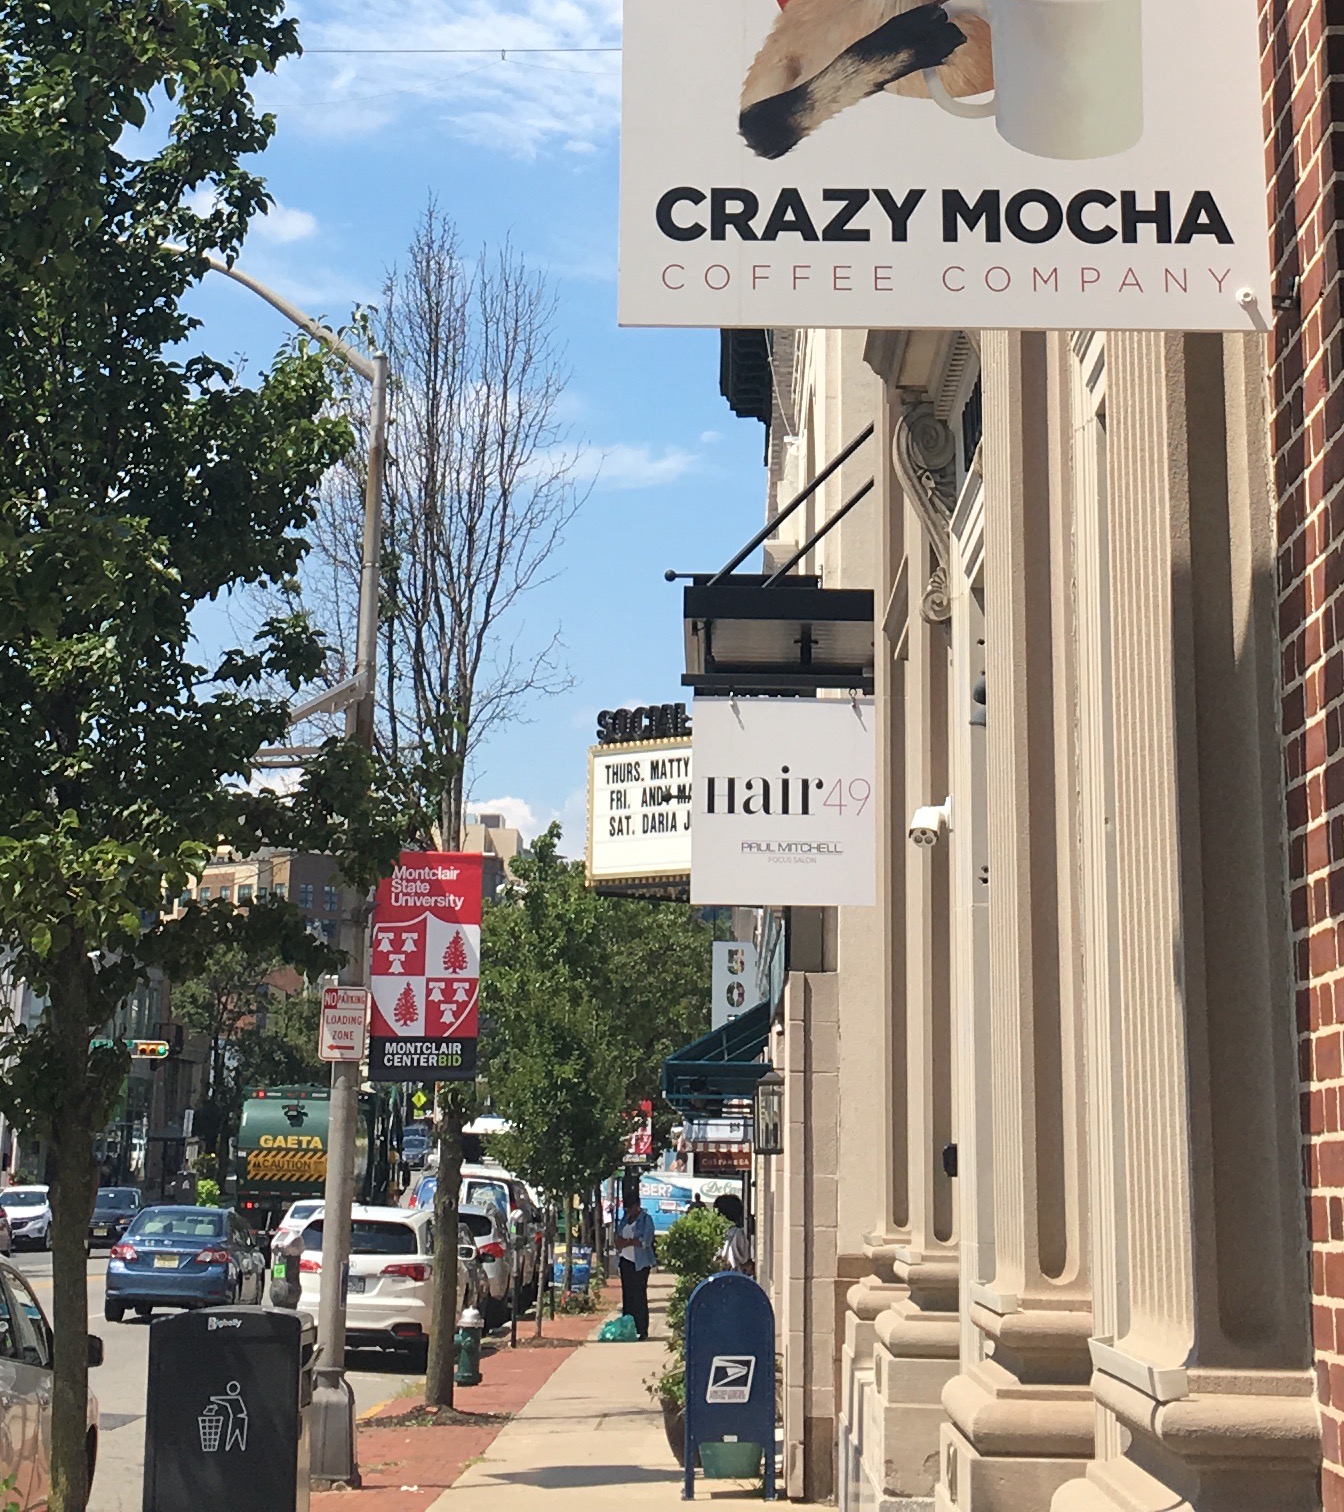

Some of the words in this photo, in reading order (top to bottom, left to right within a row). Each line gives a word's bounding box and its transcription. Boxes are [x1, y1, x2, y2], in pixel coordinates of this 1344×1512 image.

[656, 187, 926, 242] CRAZY
[942, 189, 1234, 244] MOCHA
[662, 264, 895, 292] COFFEE
[942, 265, 1232, 294] COMPANY
[605, 761, 644, 785] THURS.
[650, 757, 690, 780] MATTY
[610, 789, 631, 810] FRI.
[641, 785, 671, 807] ANDY
[609, 815, 635, 837] SAT.
[642, 811, 677, 834] DARIA
[741, 842, 775, 852] PAUL
[778, 843, 843, 854] MITCHELL
[768, 856, 791, 864] FOCUS
[392, 866, 460, 880] Montclair
[391, 879, 430, 893] State
[391, 892, 464, 910] University
[324, 992, 337, 1005] NO
[338, 994, 365, 1005] PARKING
[326, 1015, 362, 1026] LOADING
[332, 1030, 354, 1041] ZONE
[385, 1042, 461, 1054] MONTCLAIR
[259, 1135, 322, 1148] GAETA
[262, 1159, 311, 1169] CAUTION
